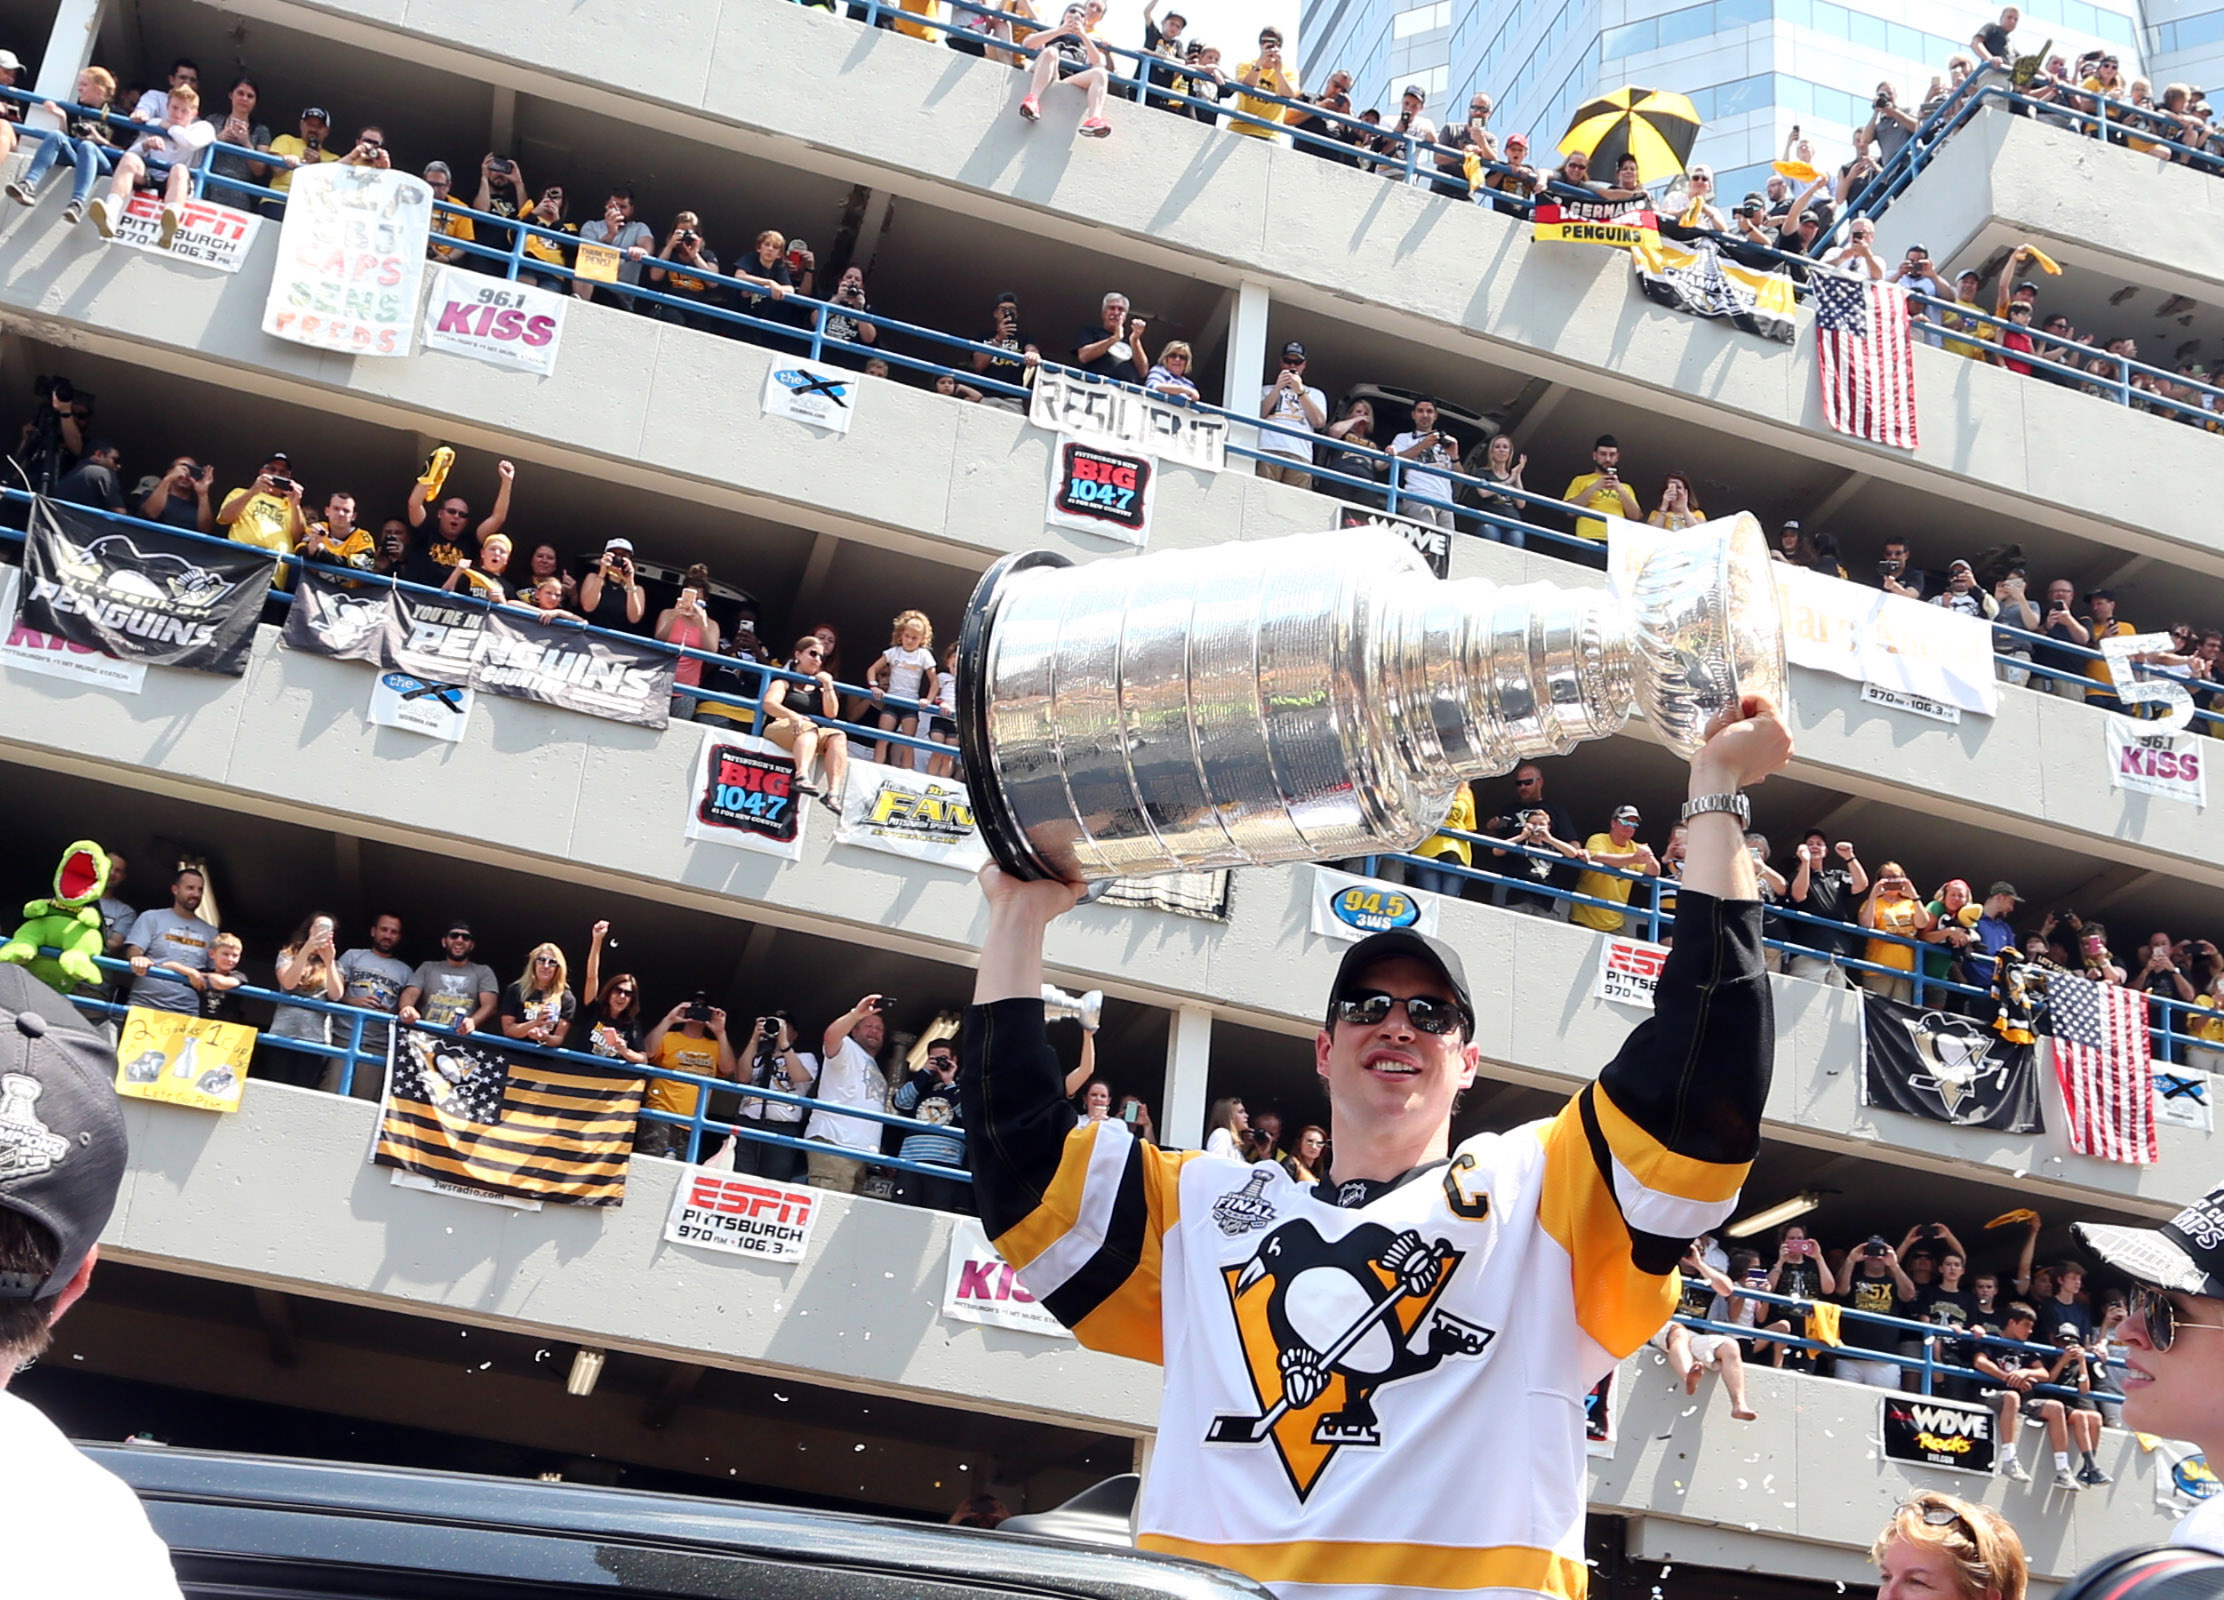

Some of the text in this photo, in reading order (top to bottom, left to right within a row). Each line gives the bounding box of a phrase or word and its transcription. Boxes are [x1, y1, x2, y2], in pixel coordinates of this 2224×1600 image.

[126, 191, 248, 240] EPN
[114, 229, 147, 245] 970
[172, 243, 216, 261] 106.3
[119, 216, 237, 252] PITTBURGH
[1562, 225, 1642, 243] PENGUINS
[296, 243, 403, 286] CAPS
[287, 281, 399, 322] SENS
[477, 288, 526, 309] 96.1
[276, 312, 398, 353] PREDS
[437, 301, 556, 346] KISS
[779, 372, 802, 385] the
[1035, 379, 1222, 463] RESILIENT
[1072, 457, 1137, 491] BIG
[1069, 478, 1135, 510] 104.7
[55, 567, 212, 619] PITTSBURGH
[28, 576, 218, 646] PENGUINS
[413, 603, 484, 630] YOU'RE IN
[406, 619, 657, 700] PENGUINS
[389, 674, 414, 689] the
[480, 665, 567, 697] COUNTRY
[2100, 631, 2196, 738] 5
[1869, 687, 1895, 702] 970
[1911, 699, 1943, 716] 106.3
[2140, 734, 2174, 750] 96.1
[718, 759, 792, 797] BIG
[721, 752, 793, 775] PITTSBURGH'S NEW
[2121, 746, 2199, 782] KISS
[713, 783, 788, 820] 104.7
[870, 789, 976, 827] FAN
[711, 807, 783, 829] #1 FOR NEW COUNTRY
[1343, 890, 1405, 917] 94.5
[1356, 914, 1392, 930] 3WS
[1604, 984, 1631, 998] 970
[129, 1019, 155, 1041] 2
[206, 1023, 220, 1047] 1
[432, 1178, 505, 1201] 3wsradio.com
[687, 1176, 812, 1226] ESPN
[1443, 1153, 1489, 1222] C
[1214, 1196, 1274, 1221] FINAL
[678, 1225, 713, 1241] 970
[738, 1236, 783, 1254] 106.3
[682, 1208, 803, 1243] PITTSBURGH
[1868, 1283, 1892, 1300] 5X
[1911, 1403, 1989, 1440] WDVE
[1916, 1431, 1973, 1453] Rocks
